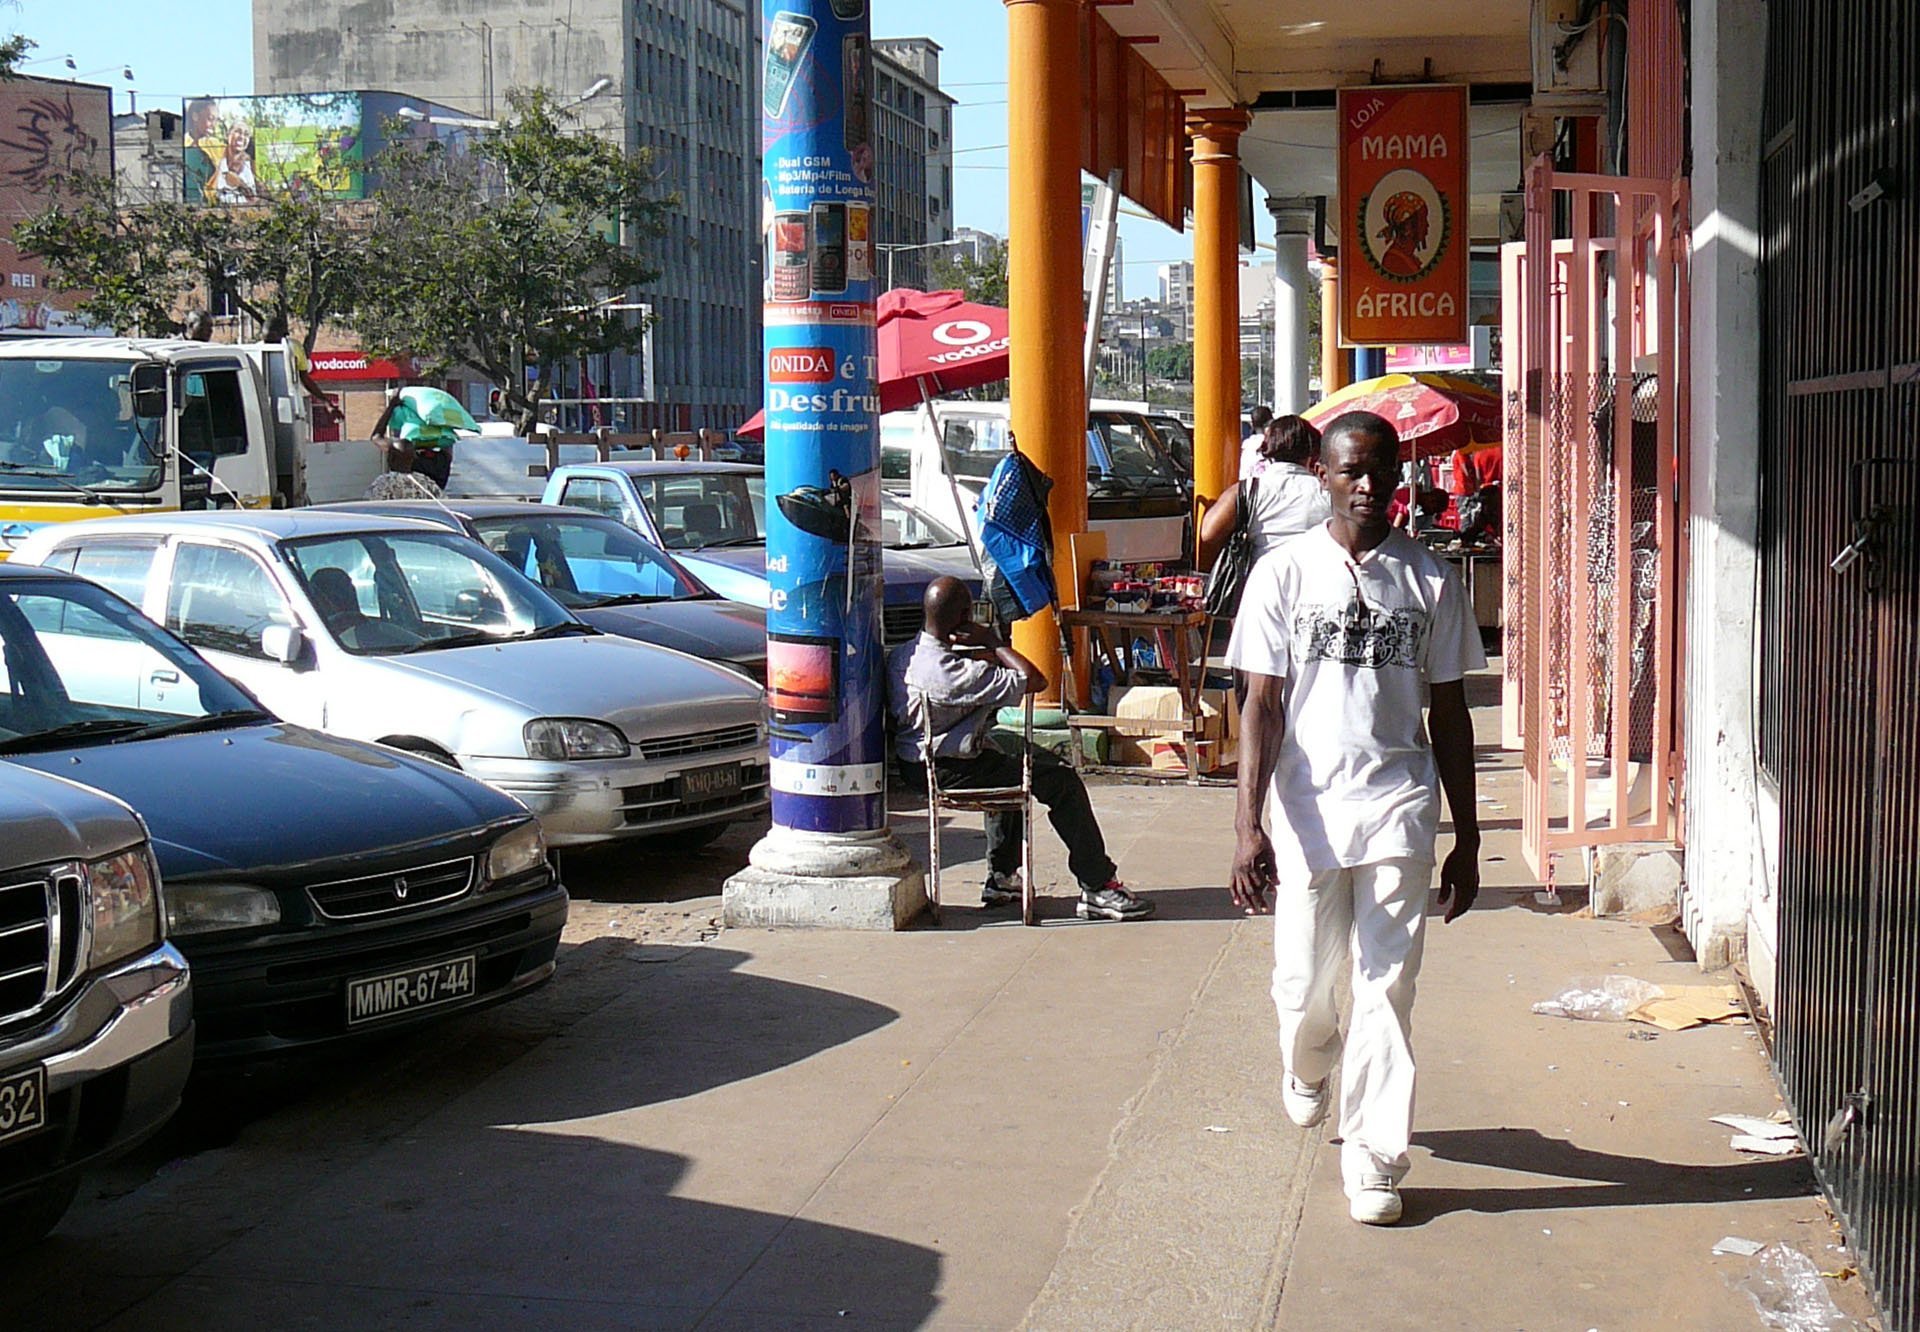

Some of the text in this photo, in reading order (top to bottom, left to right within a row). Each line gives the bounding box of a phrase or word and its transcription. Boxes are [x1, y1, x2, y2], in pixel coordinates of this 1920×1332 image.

[1350, 96, 1385, 130] LOJA
[1361, 132, 1448, 161] MAMA
[803, 157, 831, 168] GSM
[819, 185, 832, 195] de
[11, 273, 36, 289] REI
[1355, 286, 1455, 318] ÁFRICA
[315, 358, 367, 370] vodacom
[771, 355, 829, 373] ONIDA
[840, 355, 855, 379] é
[355, 962, 469, 1017] MMR-67-44
